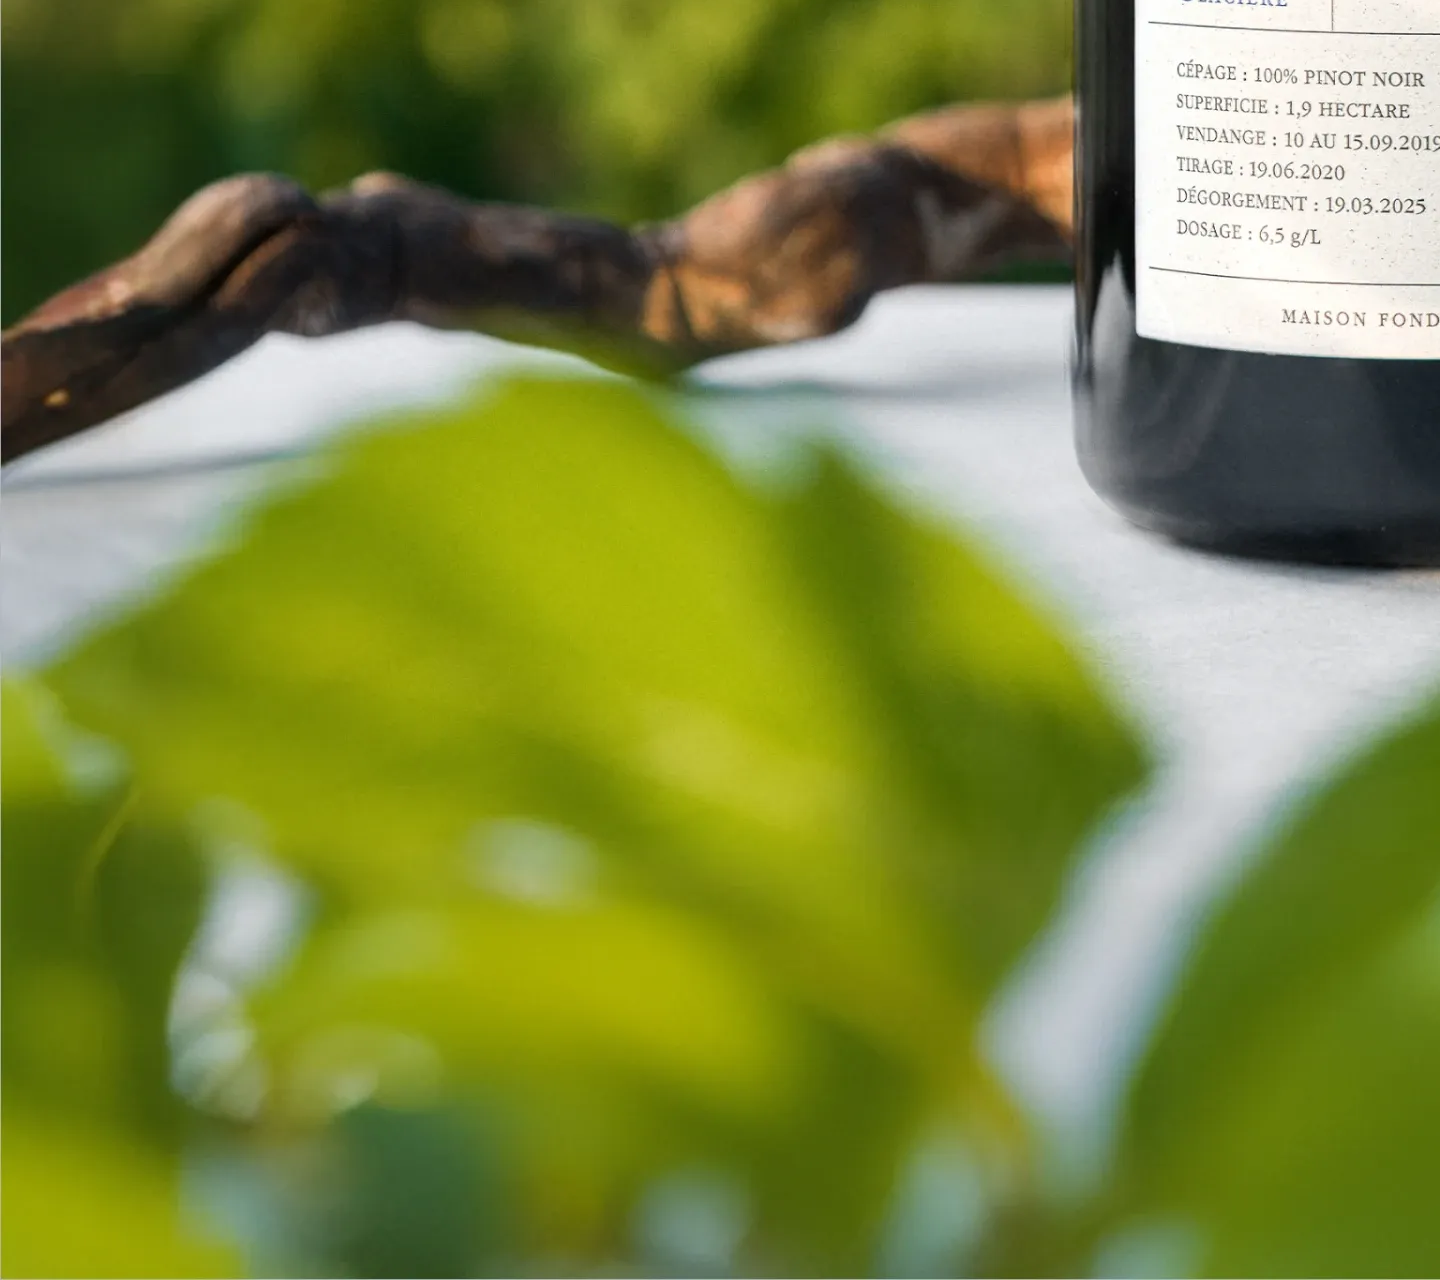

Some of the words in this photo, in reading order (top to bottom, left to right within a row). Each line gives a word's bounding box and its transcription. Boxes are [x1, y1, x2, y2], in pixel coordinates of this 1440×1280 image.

[1176, 60, 1236, 81] CÉPAGE
[1254, 66, 1298, 84] 100%
[1304, 69, 1366, 86] PINOT
[1372, 72, 1425, 87] NOIR
[1176, 94, 1268, 114] SUPERFICIE
[1286, 101, 1312, 118] 1,9
[1318, 102, 1410, 119] HECTARE
[1176, 125, 1266, 146] VENDANGE
[1284, 133, 1304, 148] 10
[1310, 134, 1335, 149] AU
[1176, 156, 1233, 175] TIRAGE
[1249, 162, 1345, 180] 19.06.2020
[1176, 187, 1307, 212] DÉGORGEMENT
[1326, 196, 1426, 214] 19.03.2025
[1176, 220, 1241, 239] DOSAGE
[1259, 227, 1284, 244] 6,5
[1291, 229, 1321, 248] g/L
[1281, 309, 1366, 327] MAISON
